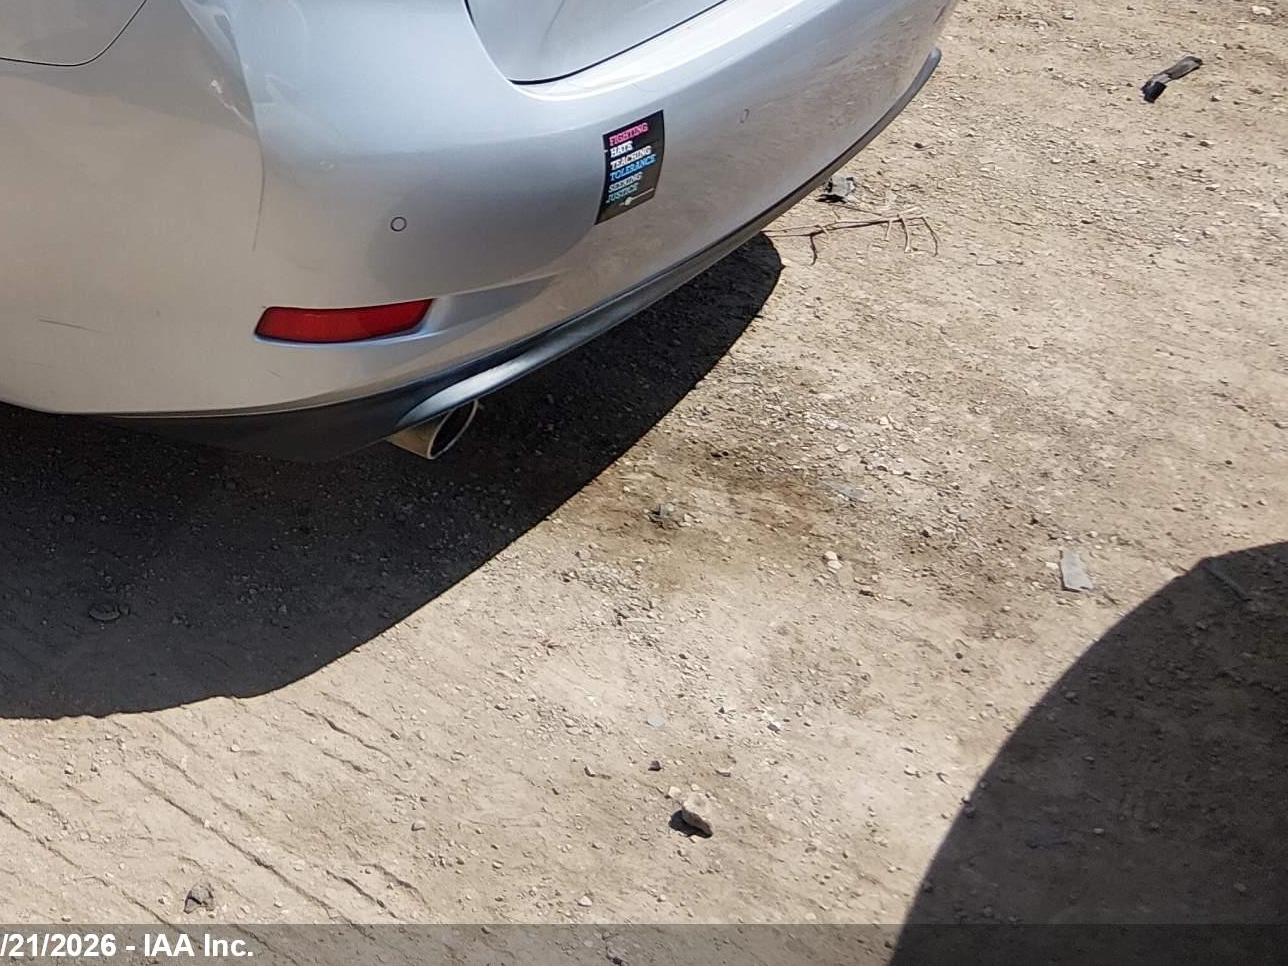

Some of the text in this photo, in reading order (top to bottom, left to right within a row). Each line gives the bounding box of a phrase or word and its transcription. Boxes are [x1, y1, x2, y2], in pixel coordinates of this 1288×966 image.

[609, 122, 649, 146] FIGHTING
[610, 140, 633, 158] HATE
[610, 145, 652, 170] TEACHING
[609, 153, 657, 181] TOLERANCE
[606, 182, 640, 204] JUSTICE
